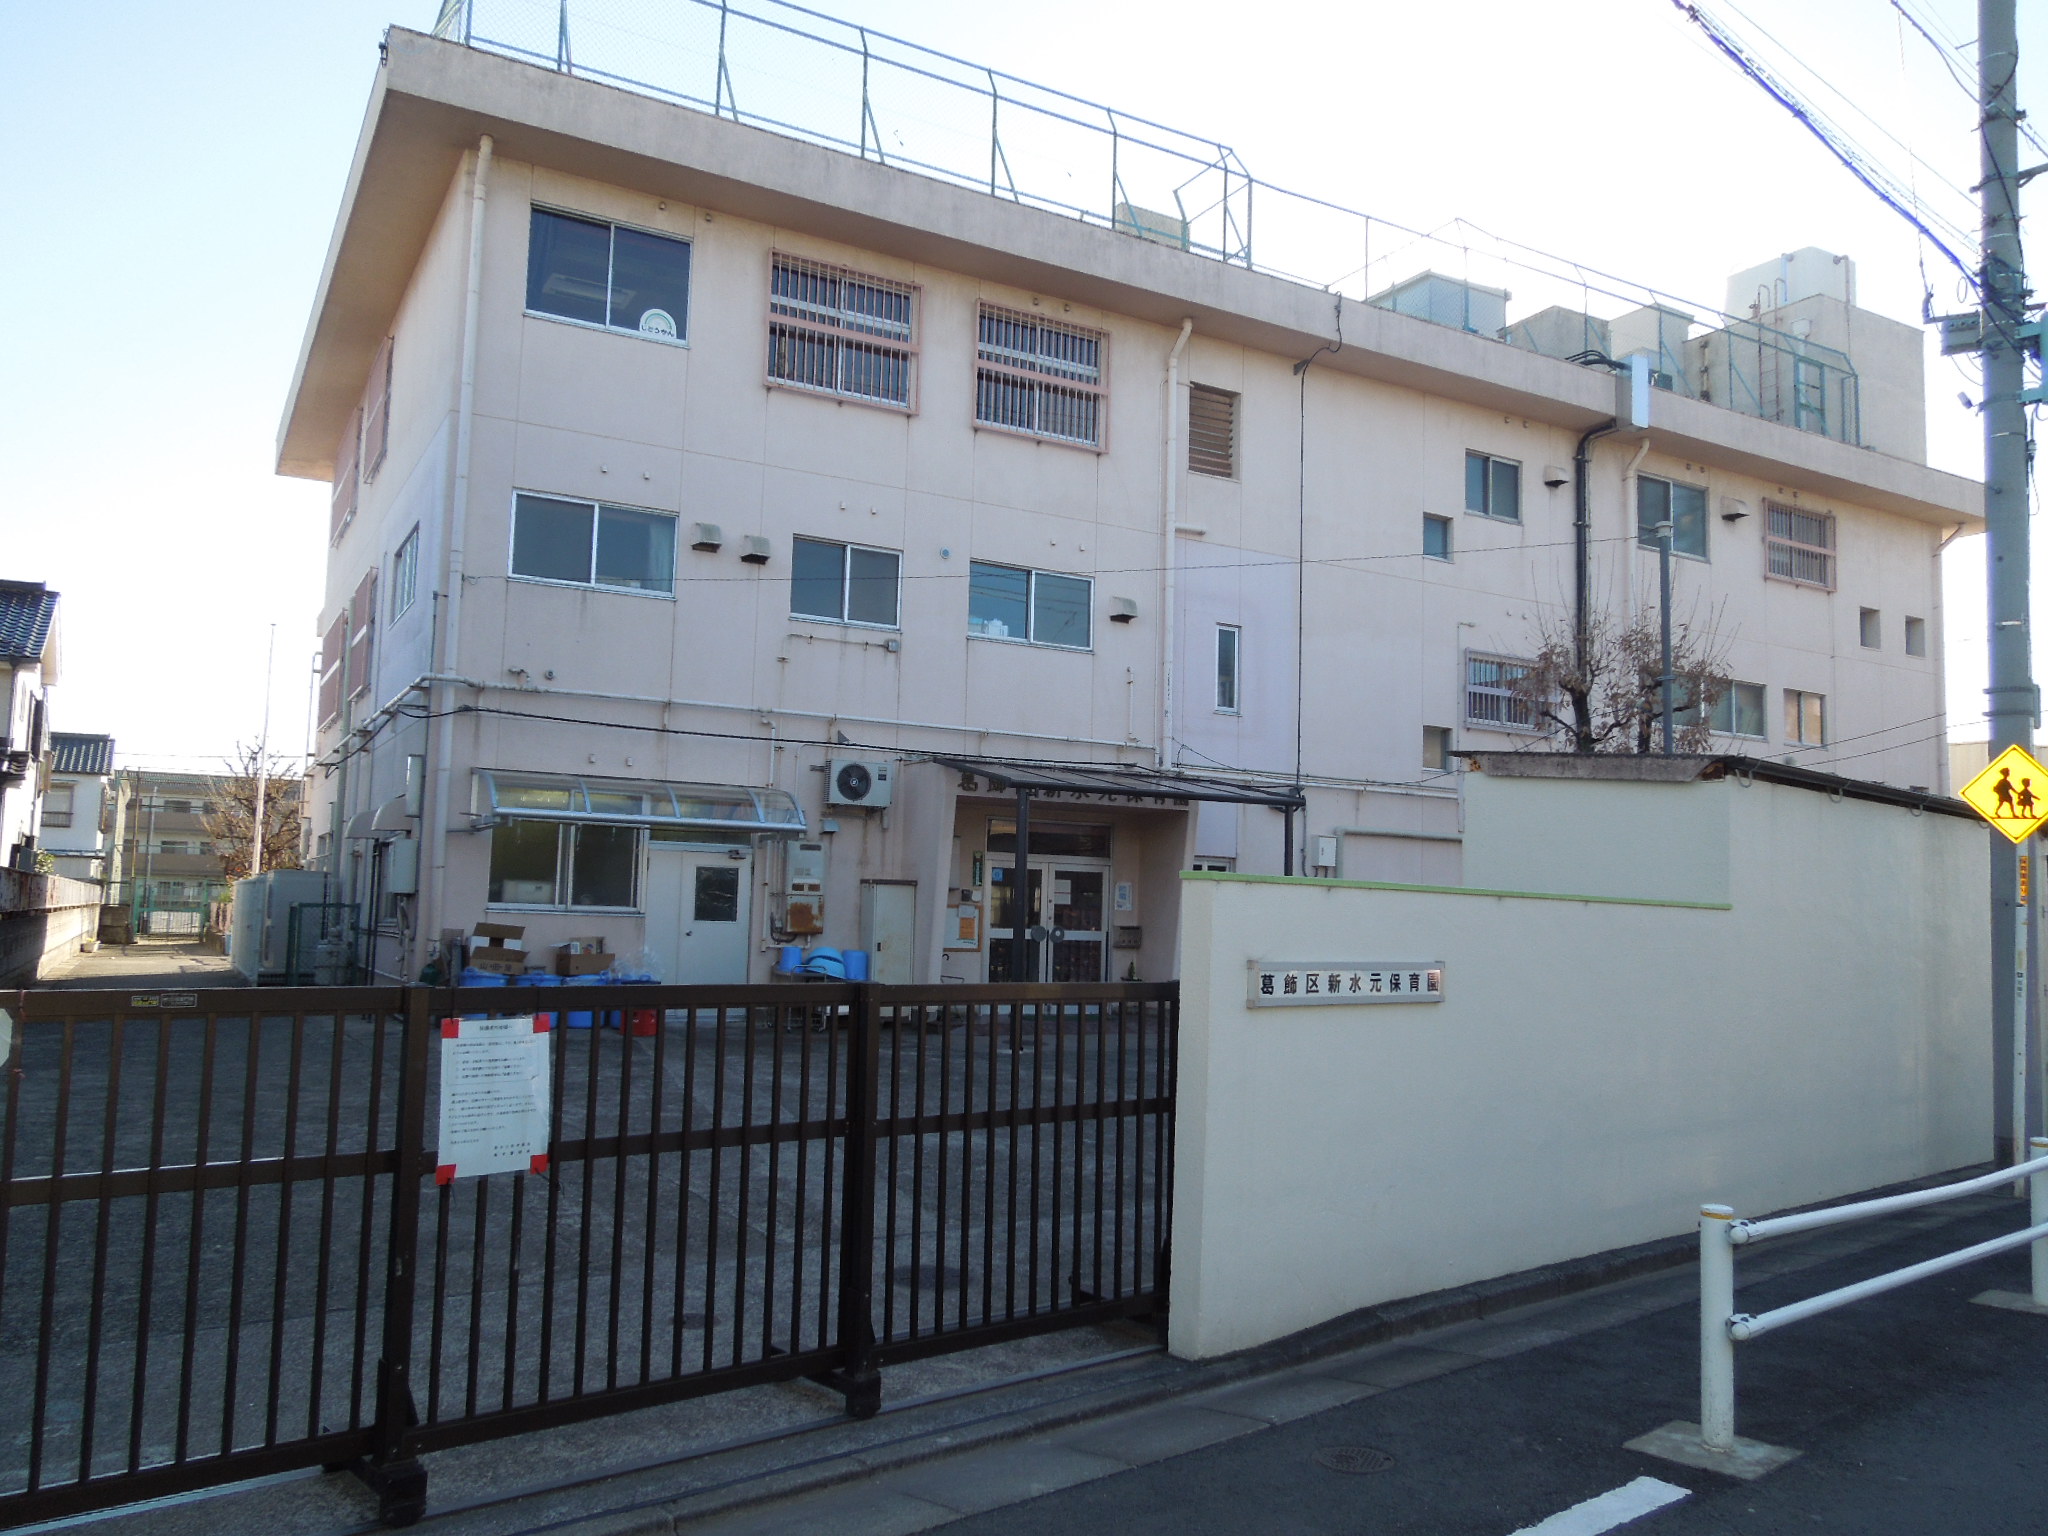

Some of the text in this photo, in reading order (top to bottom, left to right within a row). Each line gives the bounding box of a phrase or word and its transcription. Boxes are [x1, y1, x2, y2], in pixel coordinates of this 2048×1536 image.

[1260, 972, 1440, 996] 葛飾区新水元保育園
